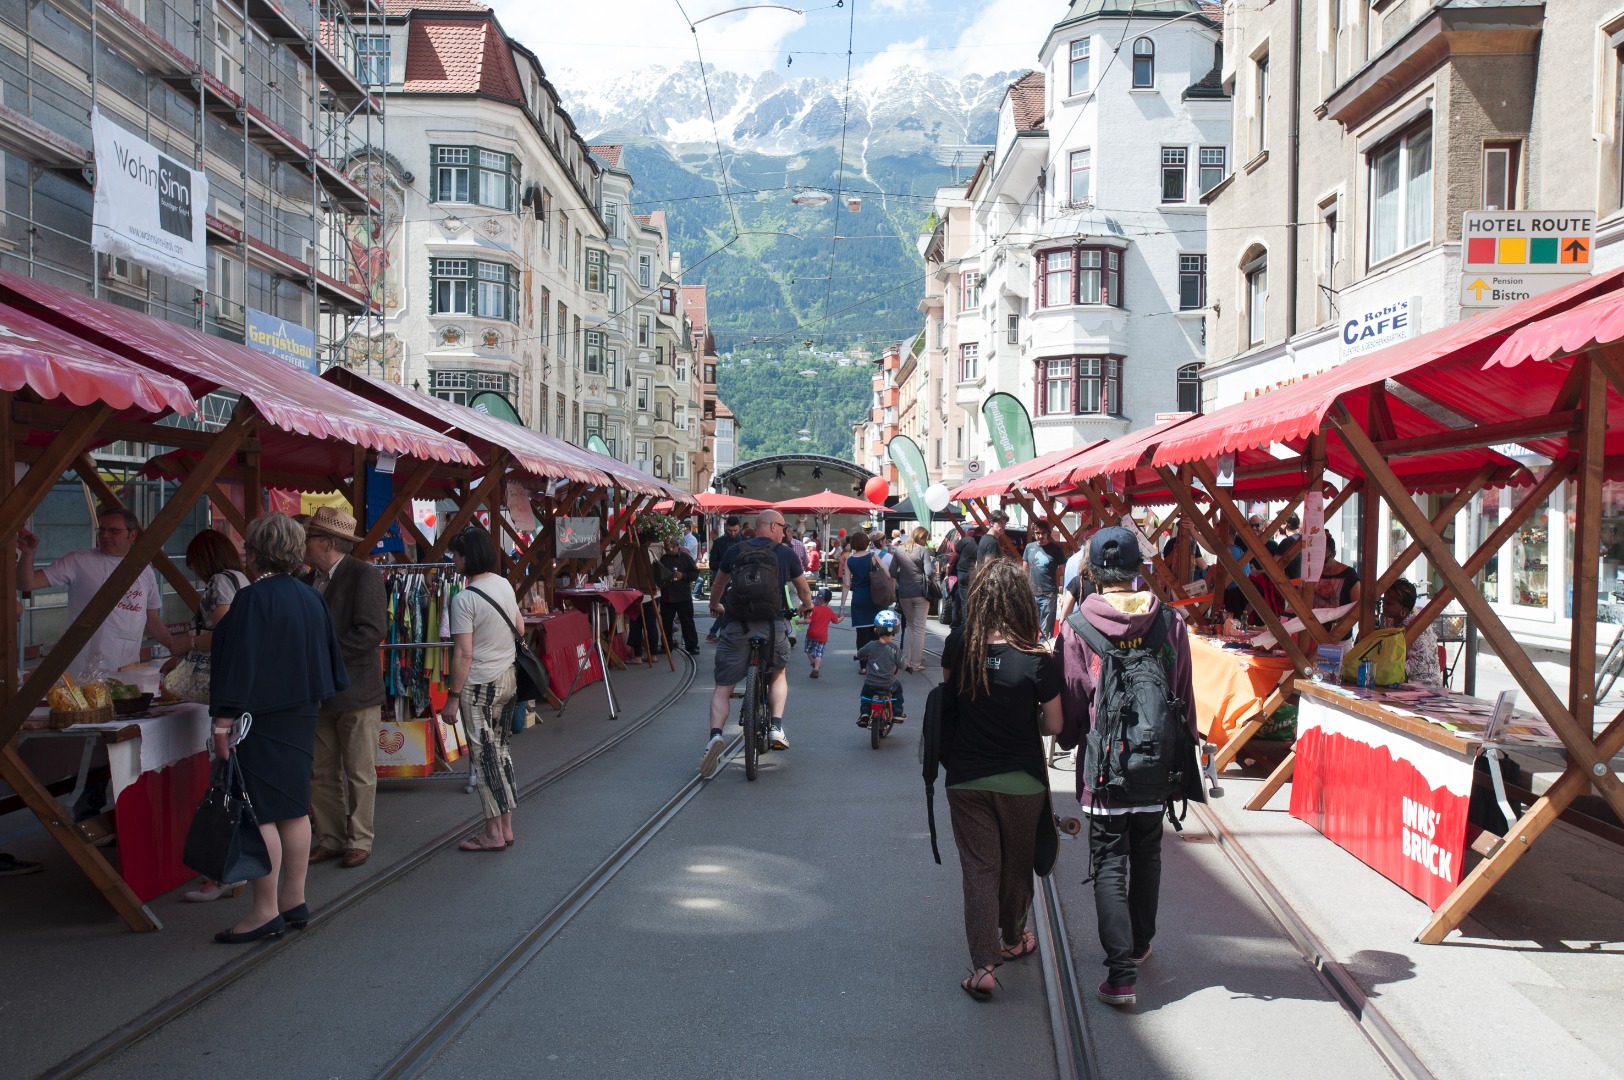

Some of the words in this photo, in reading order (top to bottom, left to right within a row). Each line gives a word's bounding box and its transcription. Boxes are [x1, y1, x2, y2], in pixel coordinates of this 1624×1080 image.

[1469, 219, 1525, 232] HOTEL
[1531, 218, 1591, 231] ROUTE
[1492, 276, 1523, 285] Pension
[1492, 289, 1530, 301] Bistro
[248, 324, 312, 359] Gerüstbau
[1343, 312, 1408, 345] CAFE
[1402, 795, 1441, 840] INNS'
[1402, 826, 1452, 883] BRUCK
